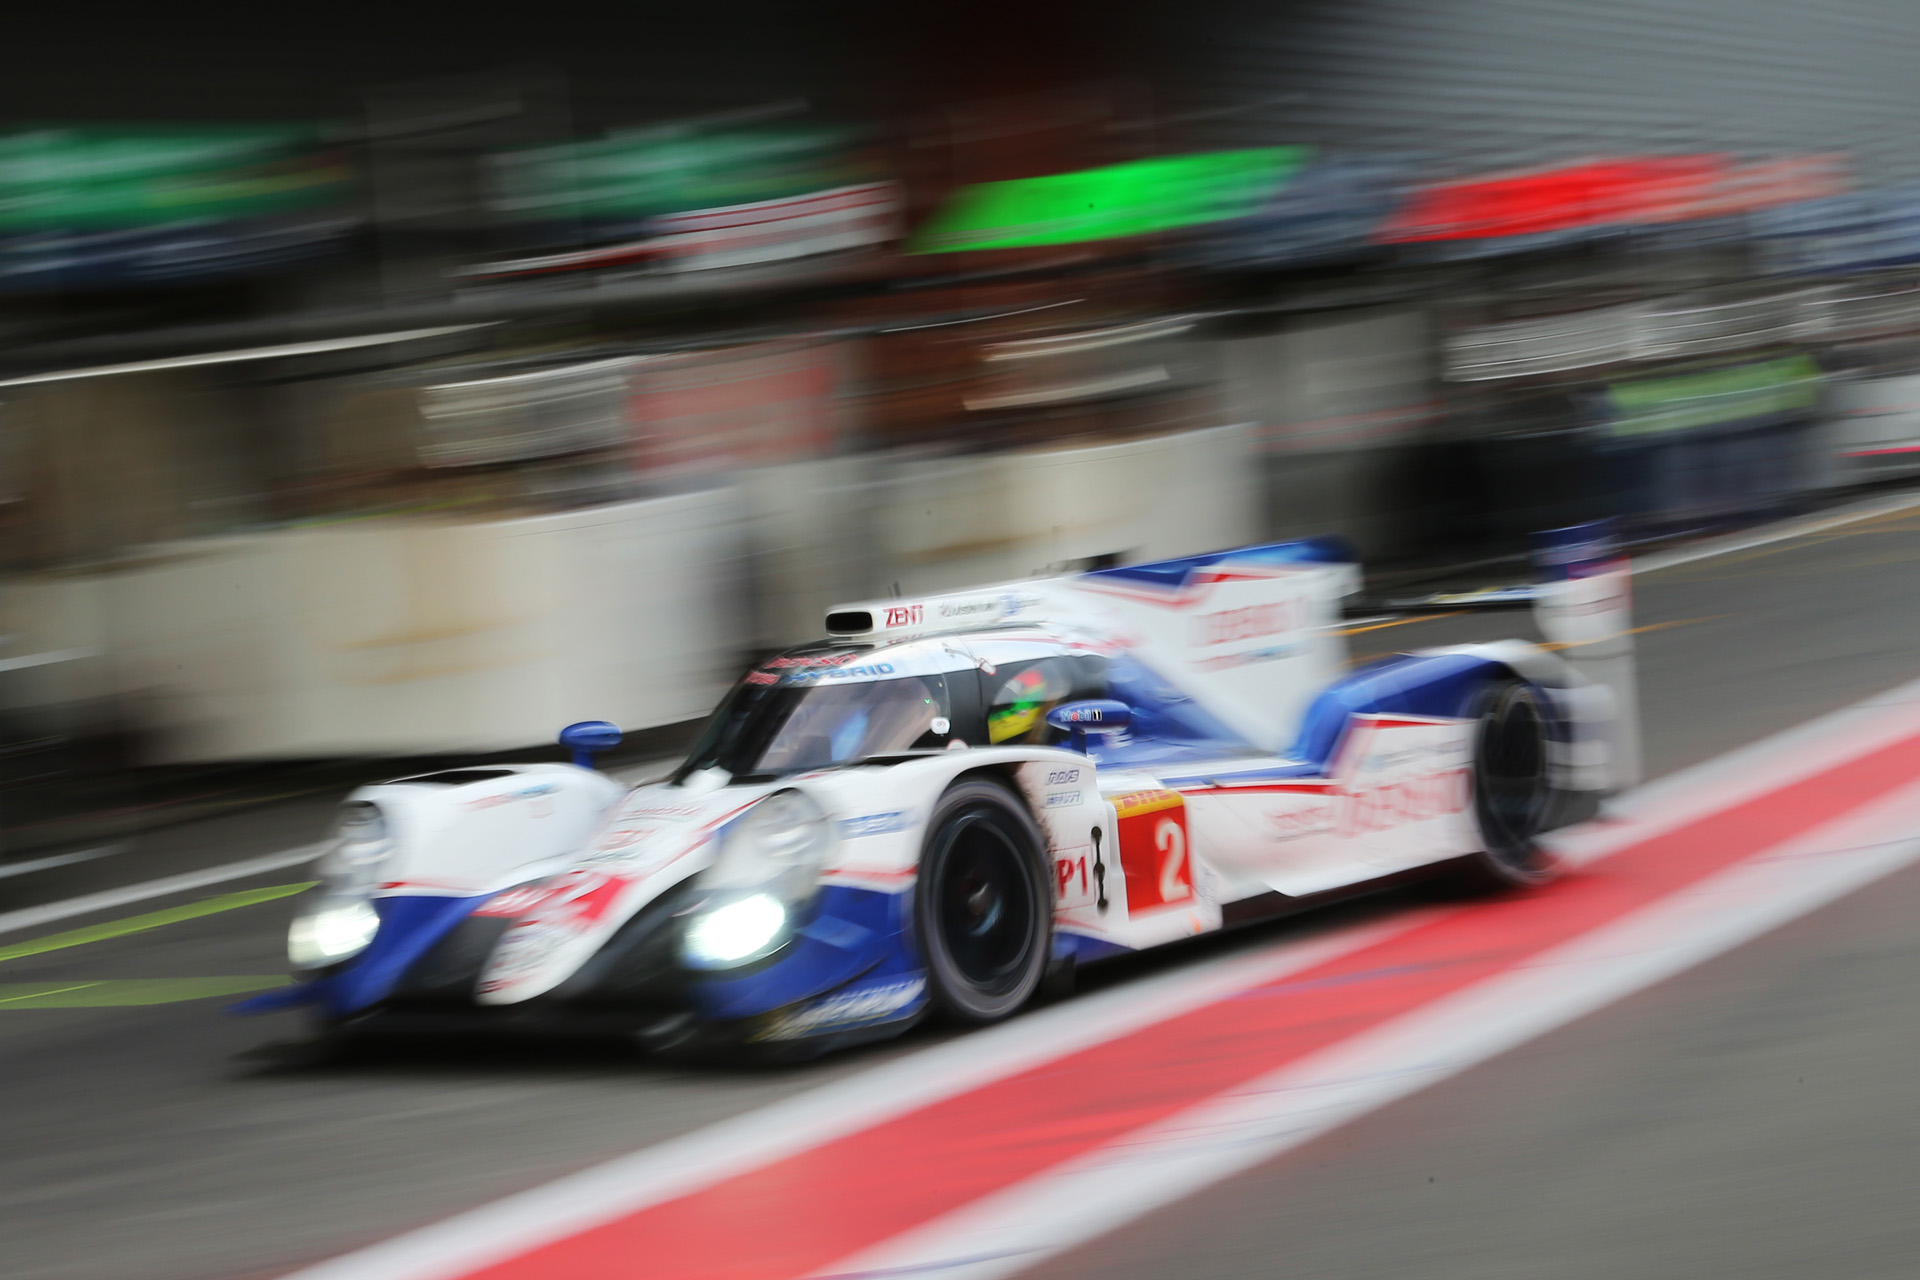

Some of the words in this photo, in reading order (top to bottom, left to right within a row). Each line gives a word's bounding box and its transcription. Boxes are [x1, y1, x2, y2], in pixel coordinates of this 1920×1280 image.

[883, 604, 923, 628] ZENT
[783, 663, 895, 684] HYBRID
[1060, 708, 1091, 722] Mobil
[1154, 816, 1191, 903] 2
